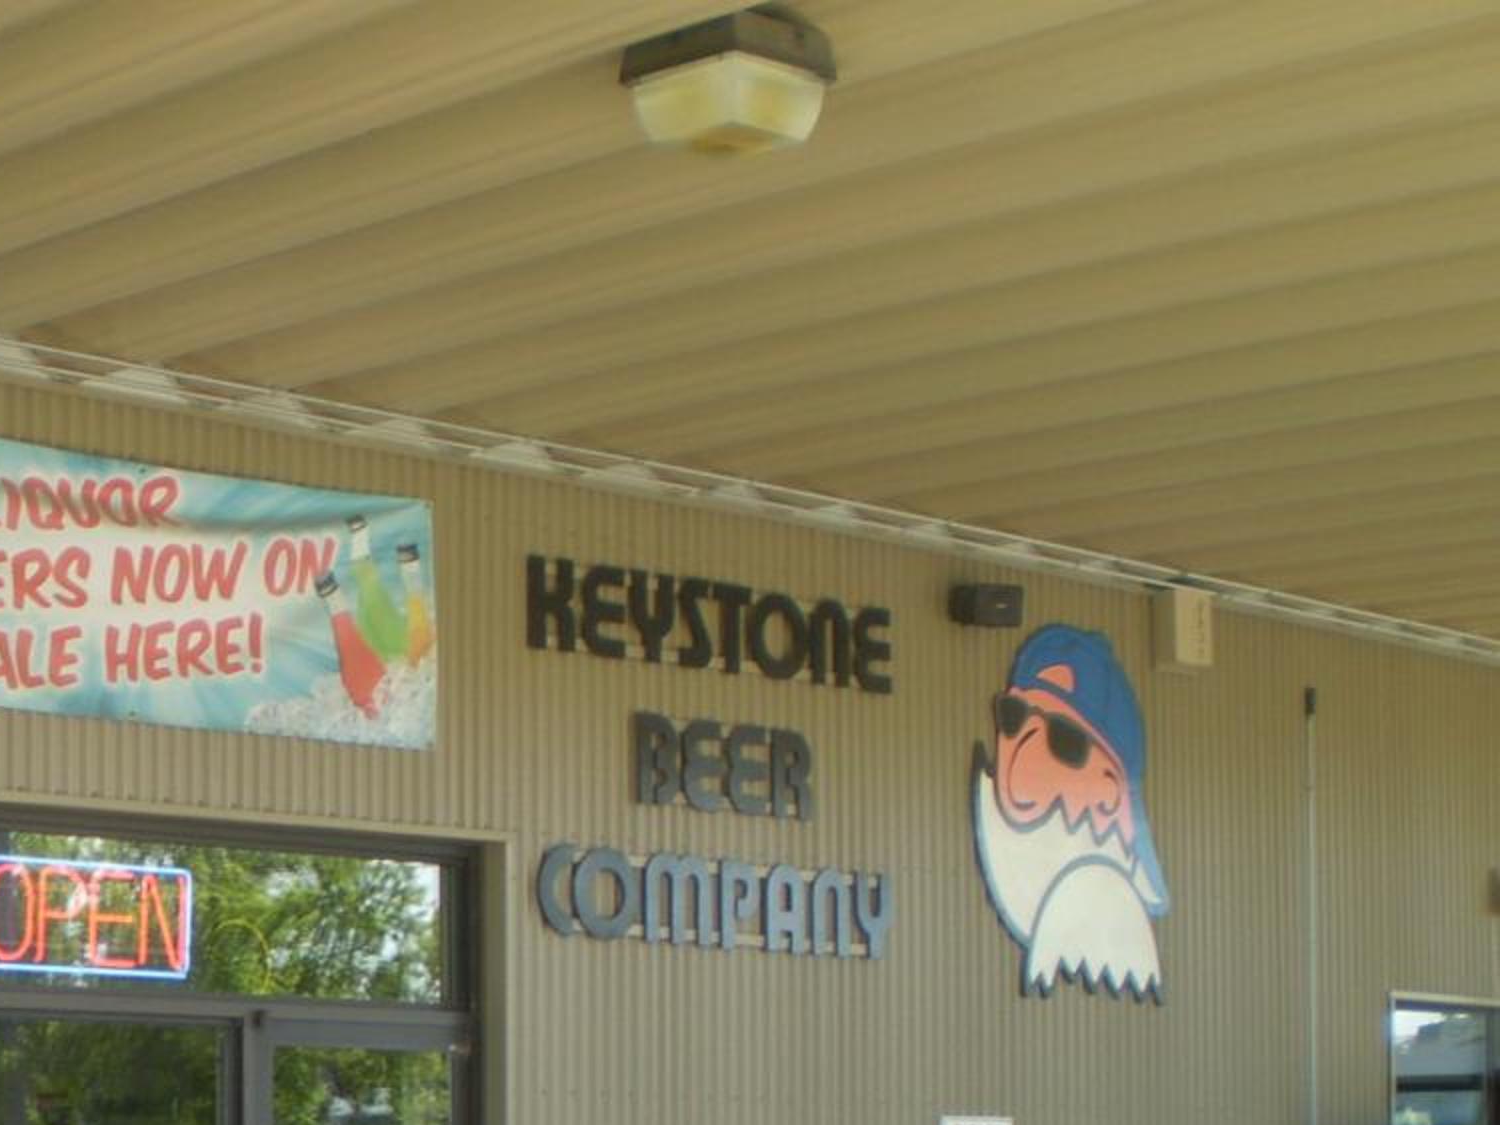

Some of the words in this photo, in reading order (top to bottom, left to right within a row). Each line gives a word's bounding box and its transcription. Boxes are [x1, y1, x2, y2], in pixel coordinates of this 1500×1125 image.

[109, 540, 249, 606] NOW
[262, 536, 338, 599] ON
[526, 554, 893, 696] KEYSTONE
[104, 613, 266, 684] HERE!
[632, 709, 815, 822] BEER
[536, 840, 894, 961] COMPANY
